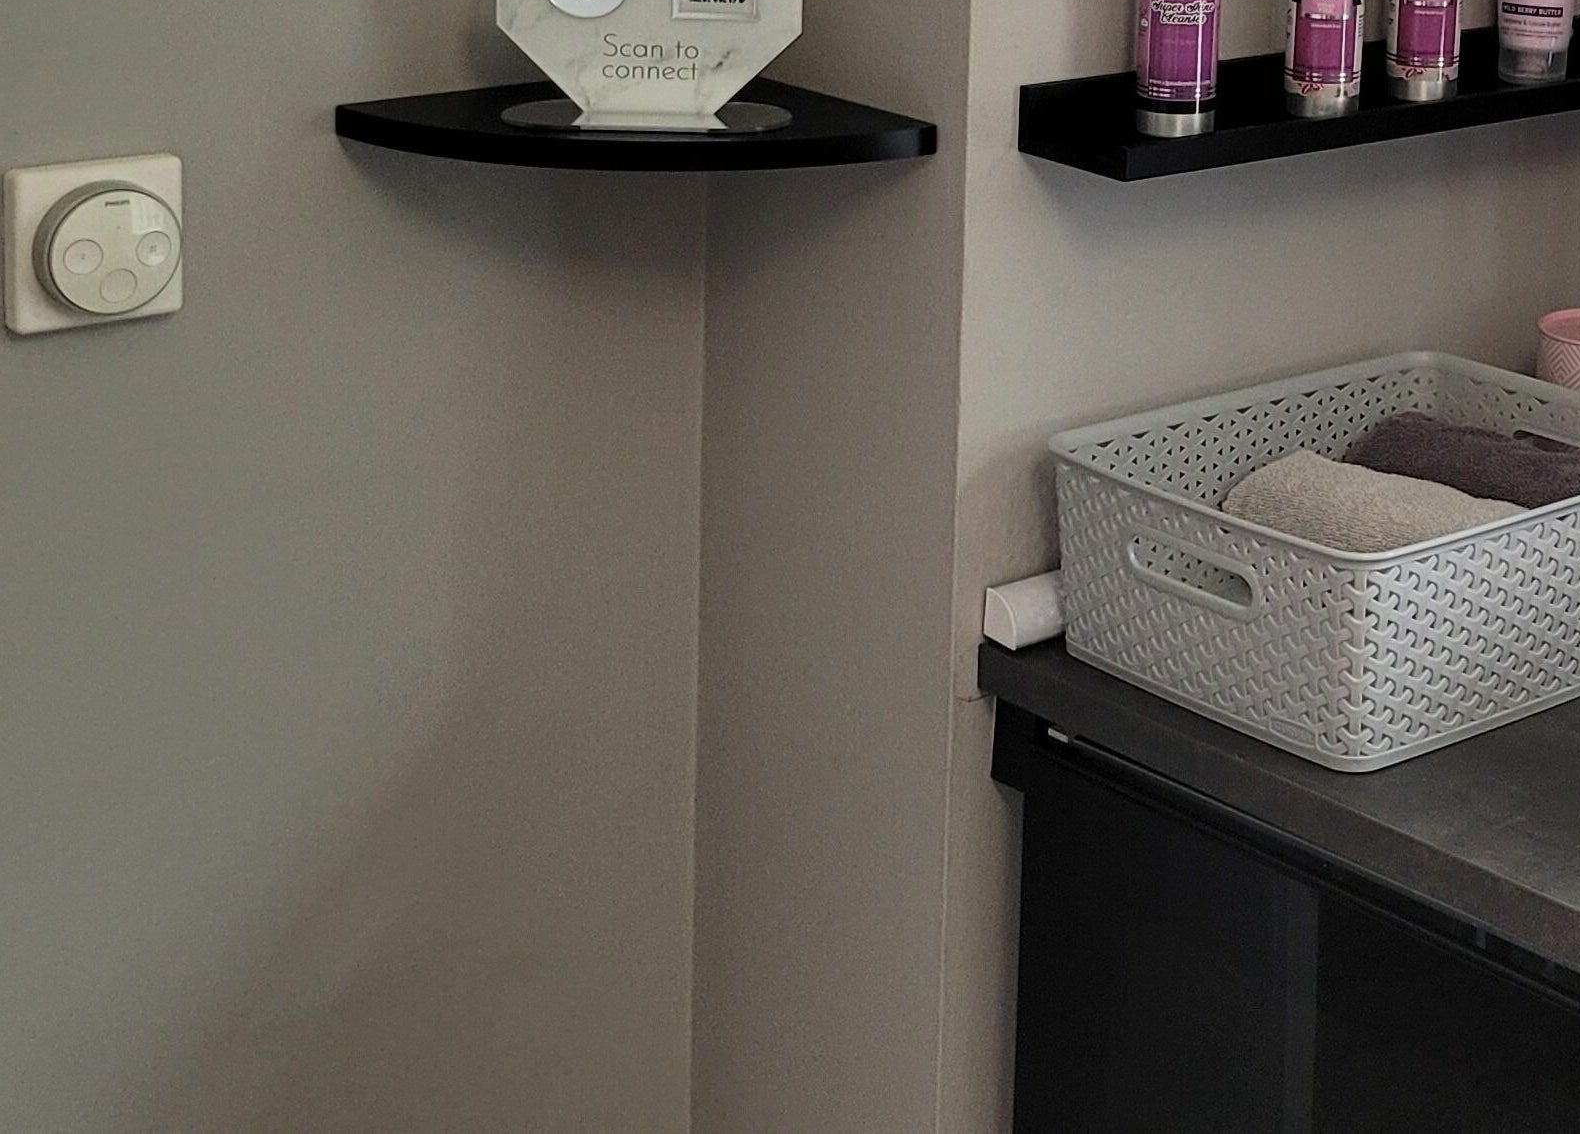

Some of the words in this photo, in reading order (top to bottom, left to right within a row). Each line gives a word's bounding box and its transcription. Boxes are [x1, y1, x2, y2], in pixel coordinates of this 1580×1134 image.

[1152, 0, 1183, 13] Super
[1517, 6, 1537, 15] BERRY
[1538, 8, 1562, 17] BUTTER
[603, 33, 663, 58] Scan
[676, 41, 699, 59] to
[602, 61, 699, 80] connect
